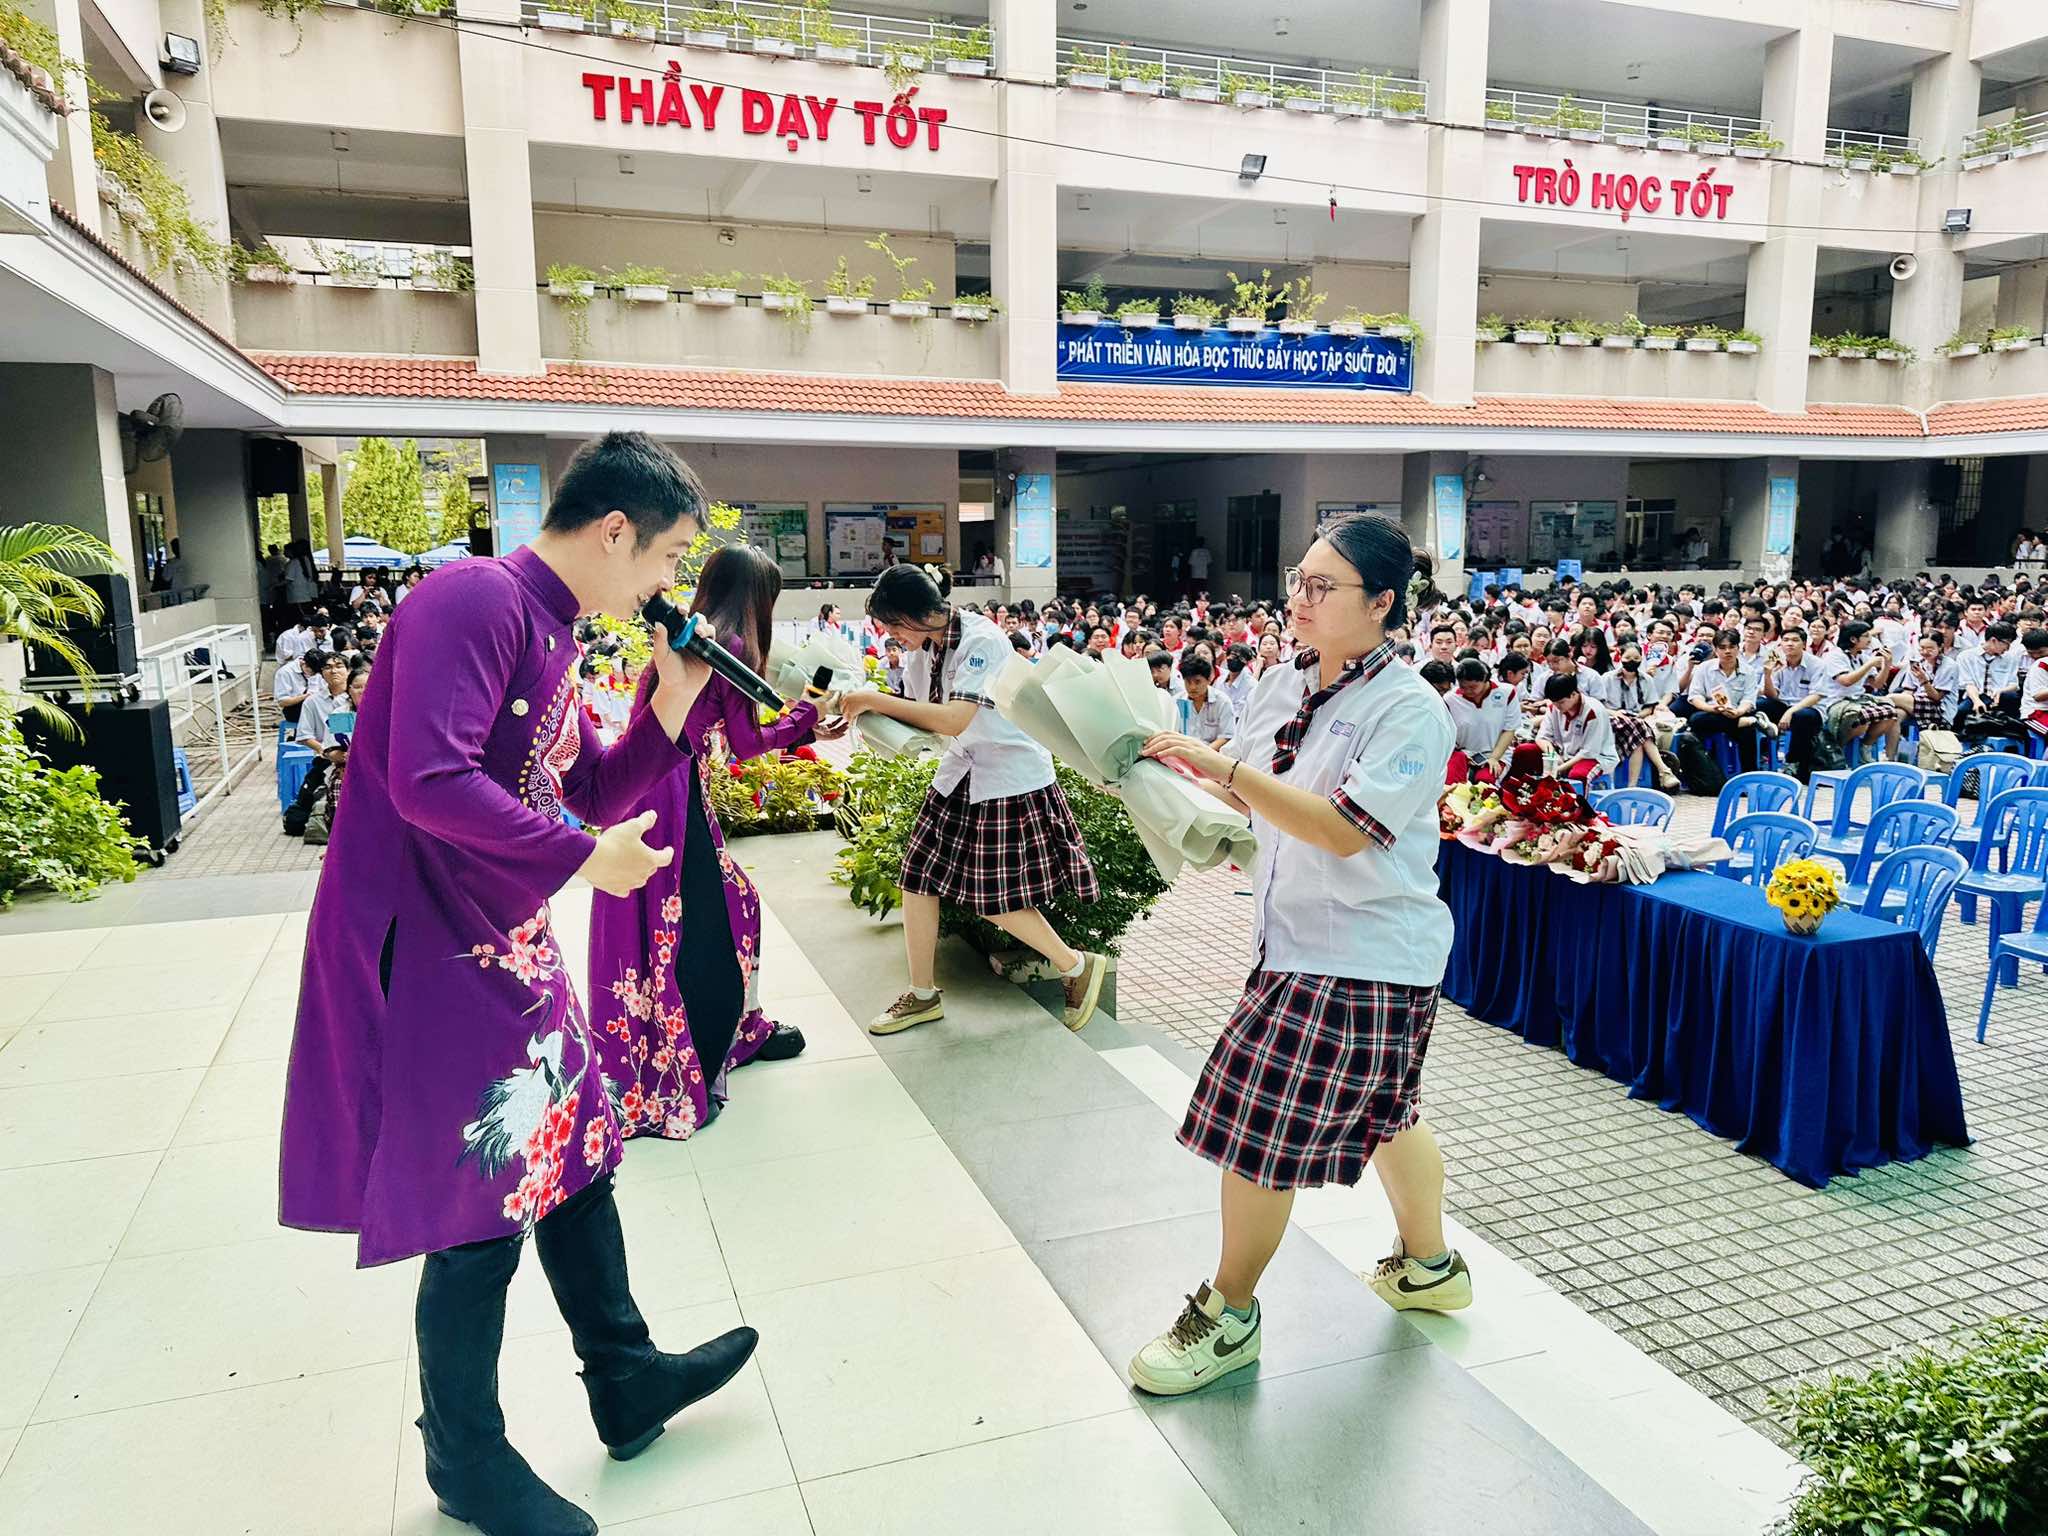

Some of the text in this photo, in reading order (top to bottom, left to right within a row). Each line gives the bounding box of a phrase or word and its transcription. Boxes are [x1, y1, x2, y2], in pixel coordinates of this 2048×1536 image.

[582, 60, 949, 152] THẦY DẠY TỐT
[1513, 159, 1735, 222] TRÒ HỌC TỐT
[1069, 337, 1102, 364] PHÁT
[1146, 339, 1171, 366] VĂN
[1174, 340, 1201, 367] HÓA
[1203, 346, 1229, 372] ĐỌC
[1293, 349, 1317, 375] HỌC
[1320, 346, 1343, 376] TẬP
